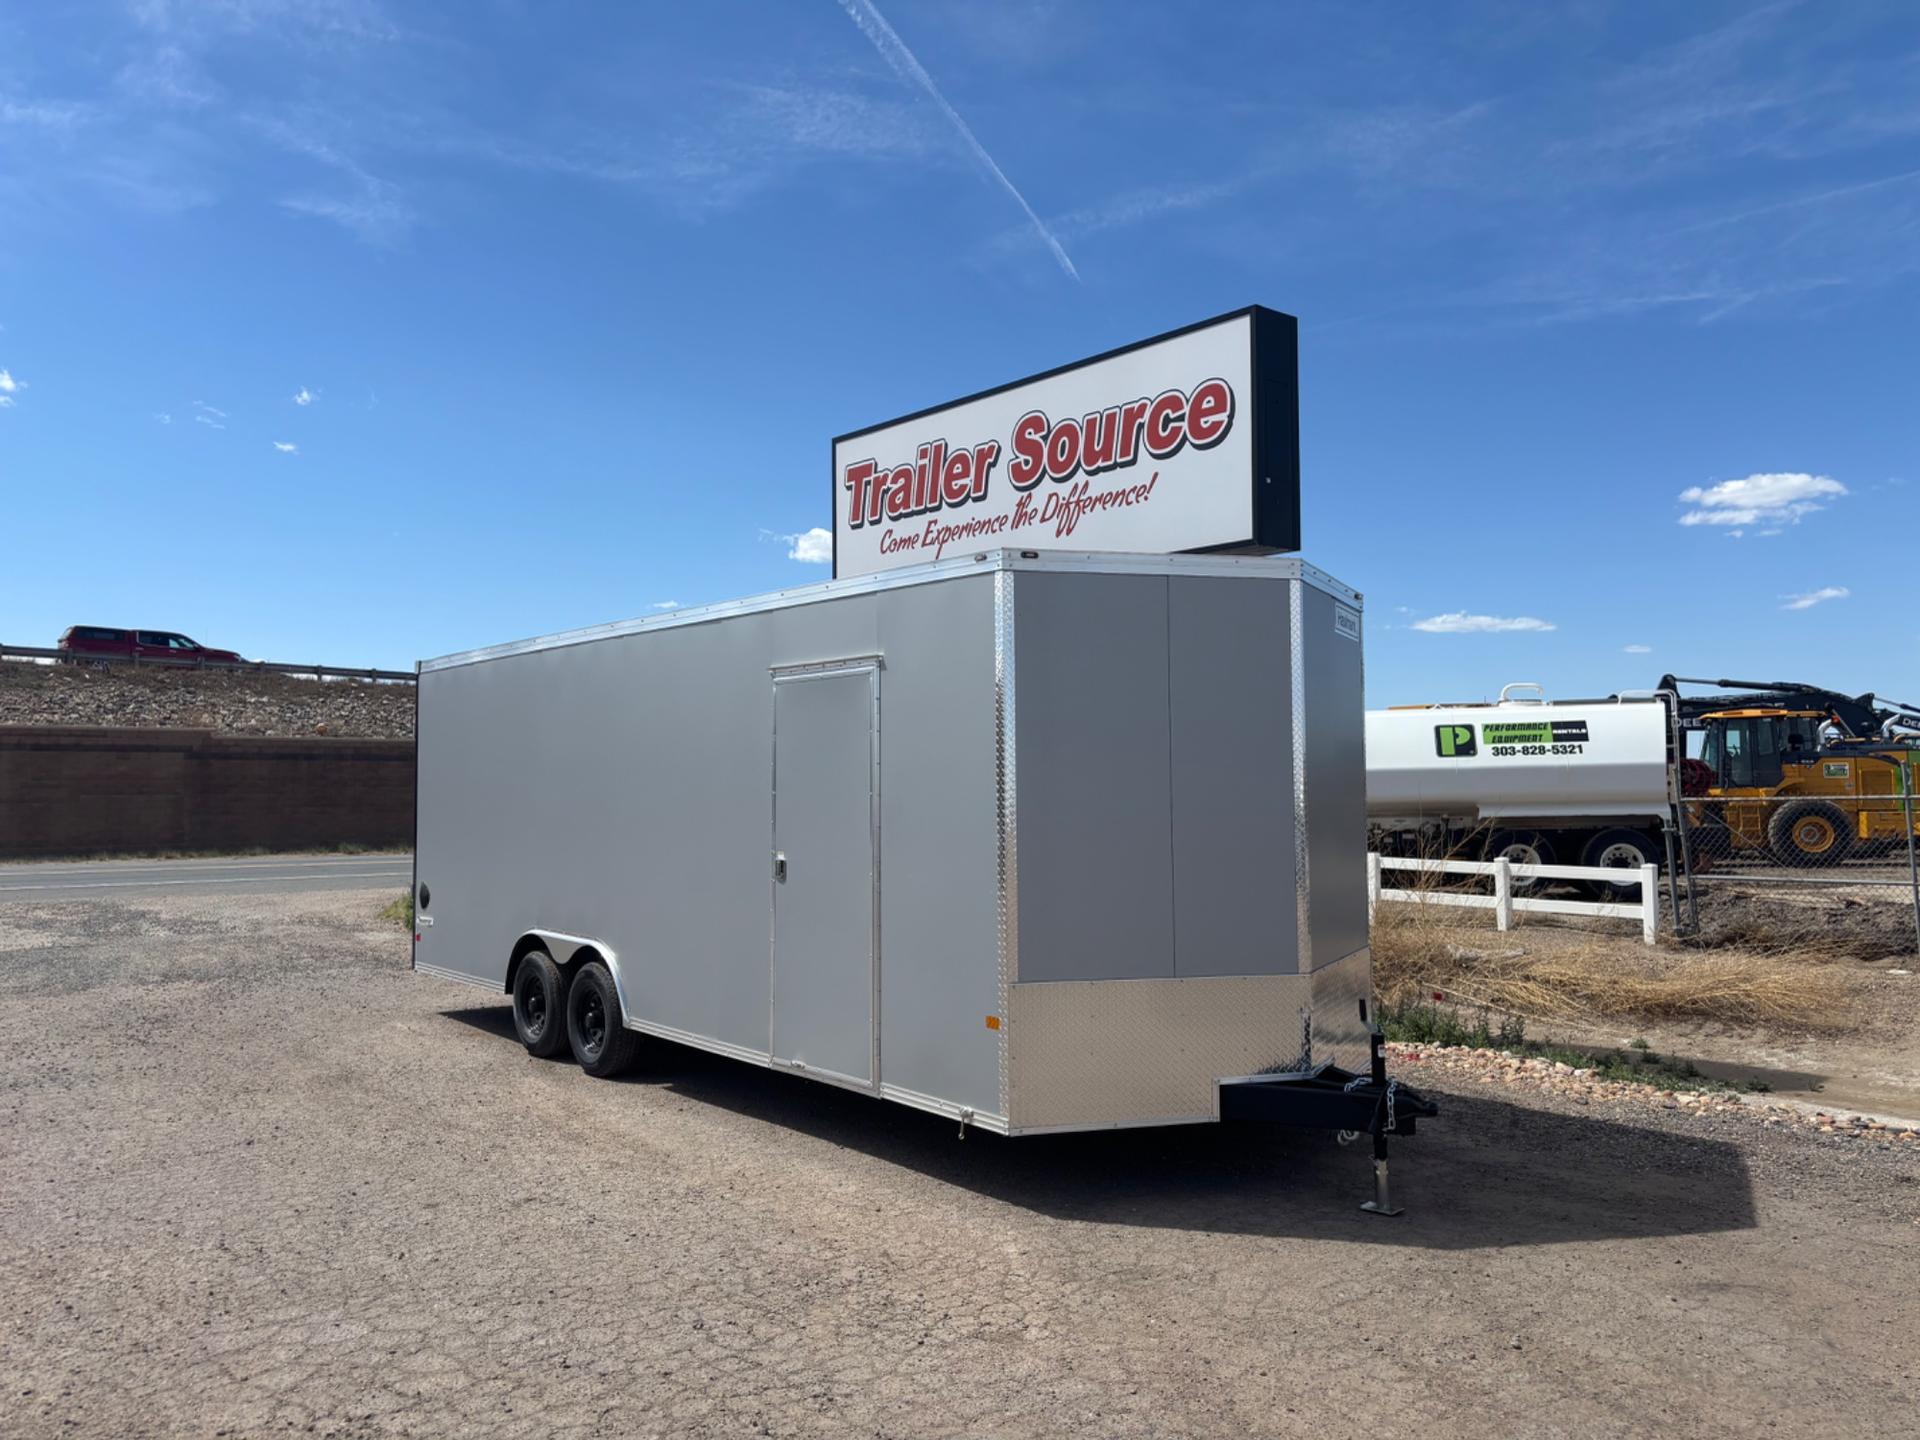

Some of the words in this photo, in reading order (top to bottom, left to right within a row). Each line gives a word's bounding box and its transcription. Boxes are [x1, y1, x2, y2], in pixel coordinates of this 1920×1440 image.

[845, 439, 1000, 529] Trailer
[1008, 377, 1235, 492] Source
[880, 529, 919, 555] Come
[921, 519, 1009, 560] Experience
[1040, 472, 1159, 538] Difference!
[1483, 722, 1549, 732] PERFORMANCE
[1491, 734, 1543, 744] EQUIPMENT
[1491, 744, 1583, 757] 303-828-5321
